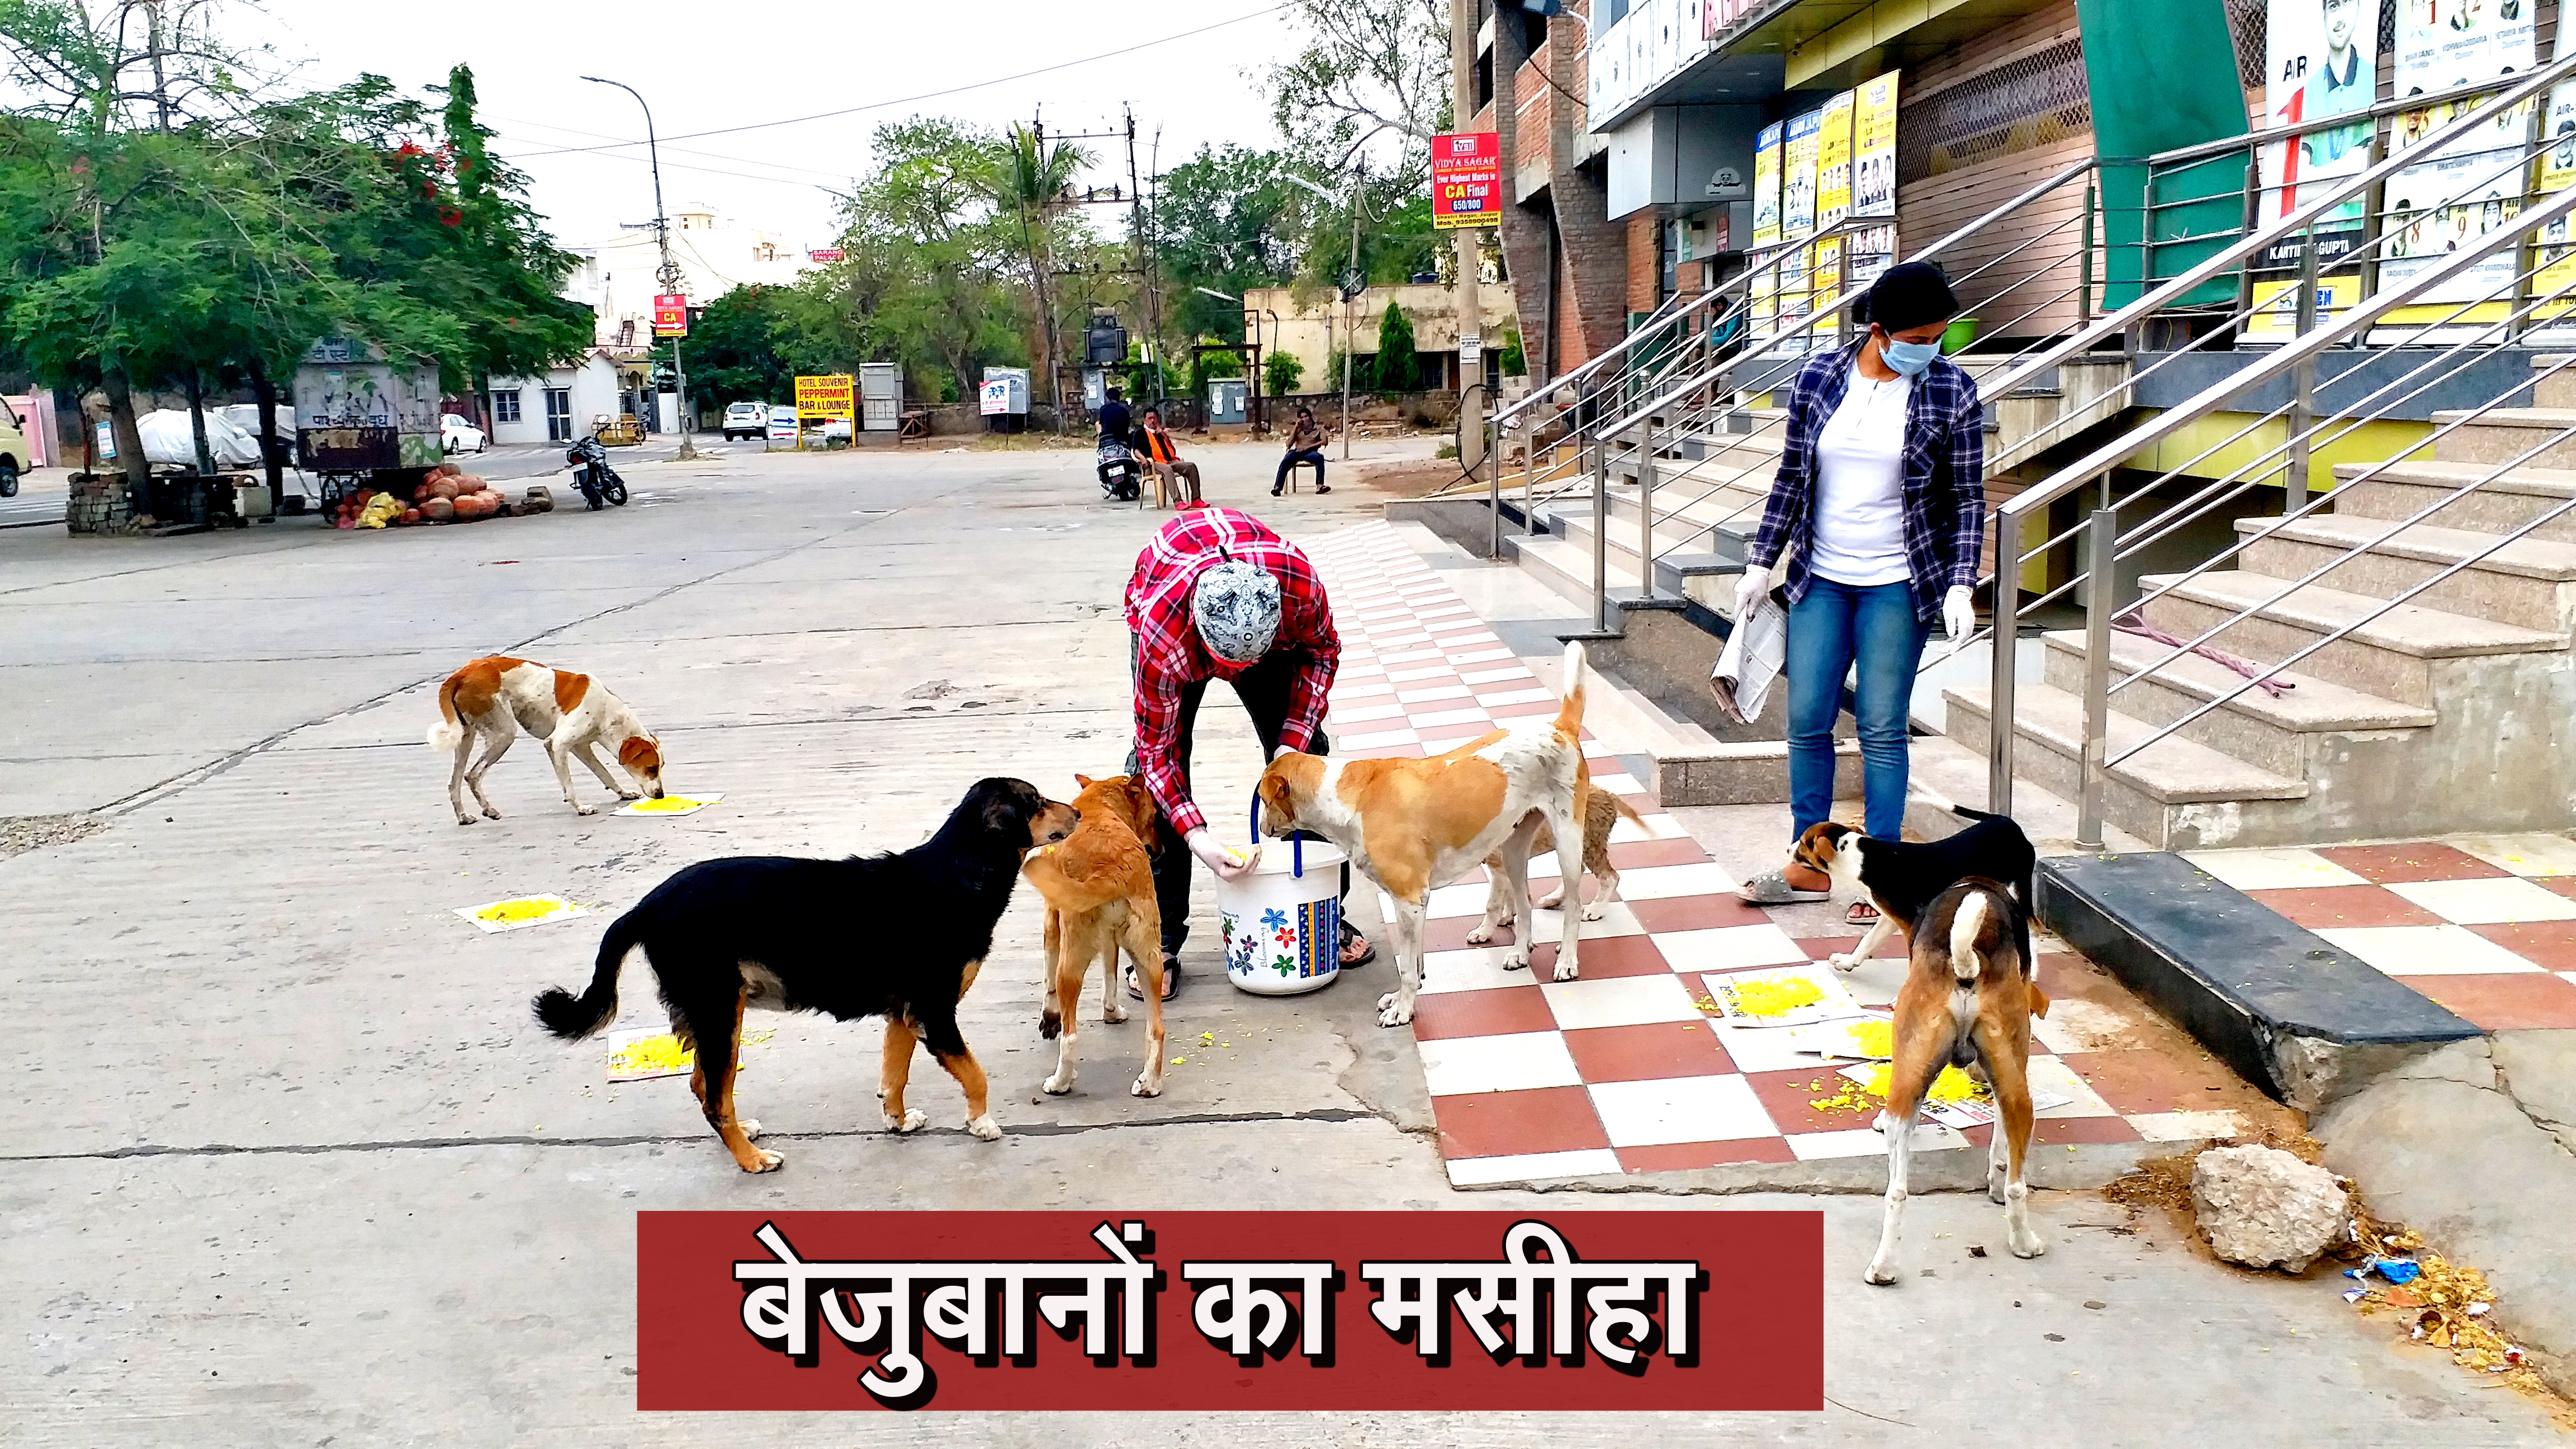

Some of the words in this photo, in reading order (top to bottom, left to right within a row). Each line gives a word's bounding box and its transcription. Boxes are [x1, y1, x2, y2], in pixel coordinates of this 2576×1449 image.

[2283, 55, 2307, 82] AIR
[1434, 158, 1461, 168] VIDYA
[1464, 157, 1495, 167] SAGAR
[1437, 175, 1448, 184] Ever
[1450, 173, 1471, 184] Highest
[1472, 172, 1489, 182] Marks
[1490, 172, 1495, 181] in
[1445, 185, 1465, 199] CA
[1467, 183, 1488, 197] Final
[1453, 198, 1481, 211] 650/800
[2457, 216, 2466, 240] 9
[2318, 239, 2350, 256] GUPTA
[664, 312, 676, 322] CA
[799, 378, 816, 387] HOTEL
[818, 378, 848, 387] SOUVENIR
[799, 389, 849, 399] PEPPERMINT
[799, 401, 815, 410] BAR
[822, 400, 850, 410] LOUNGE
